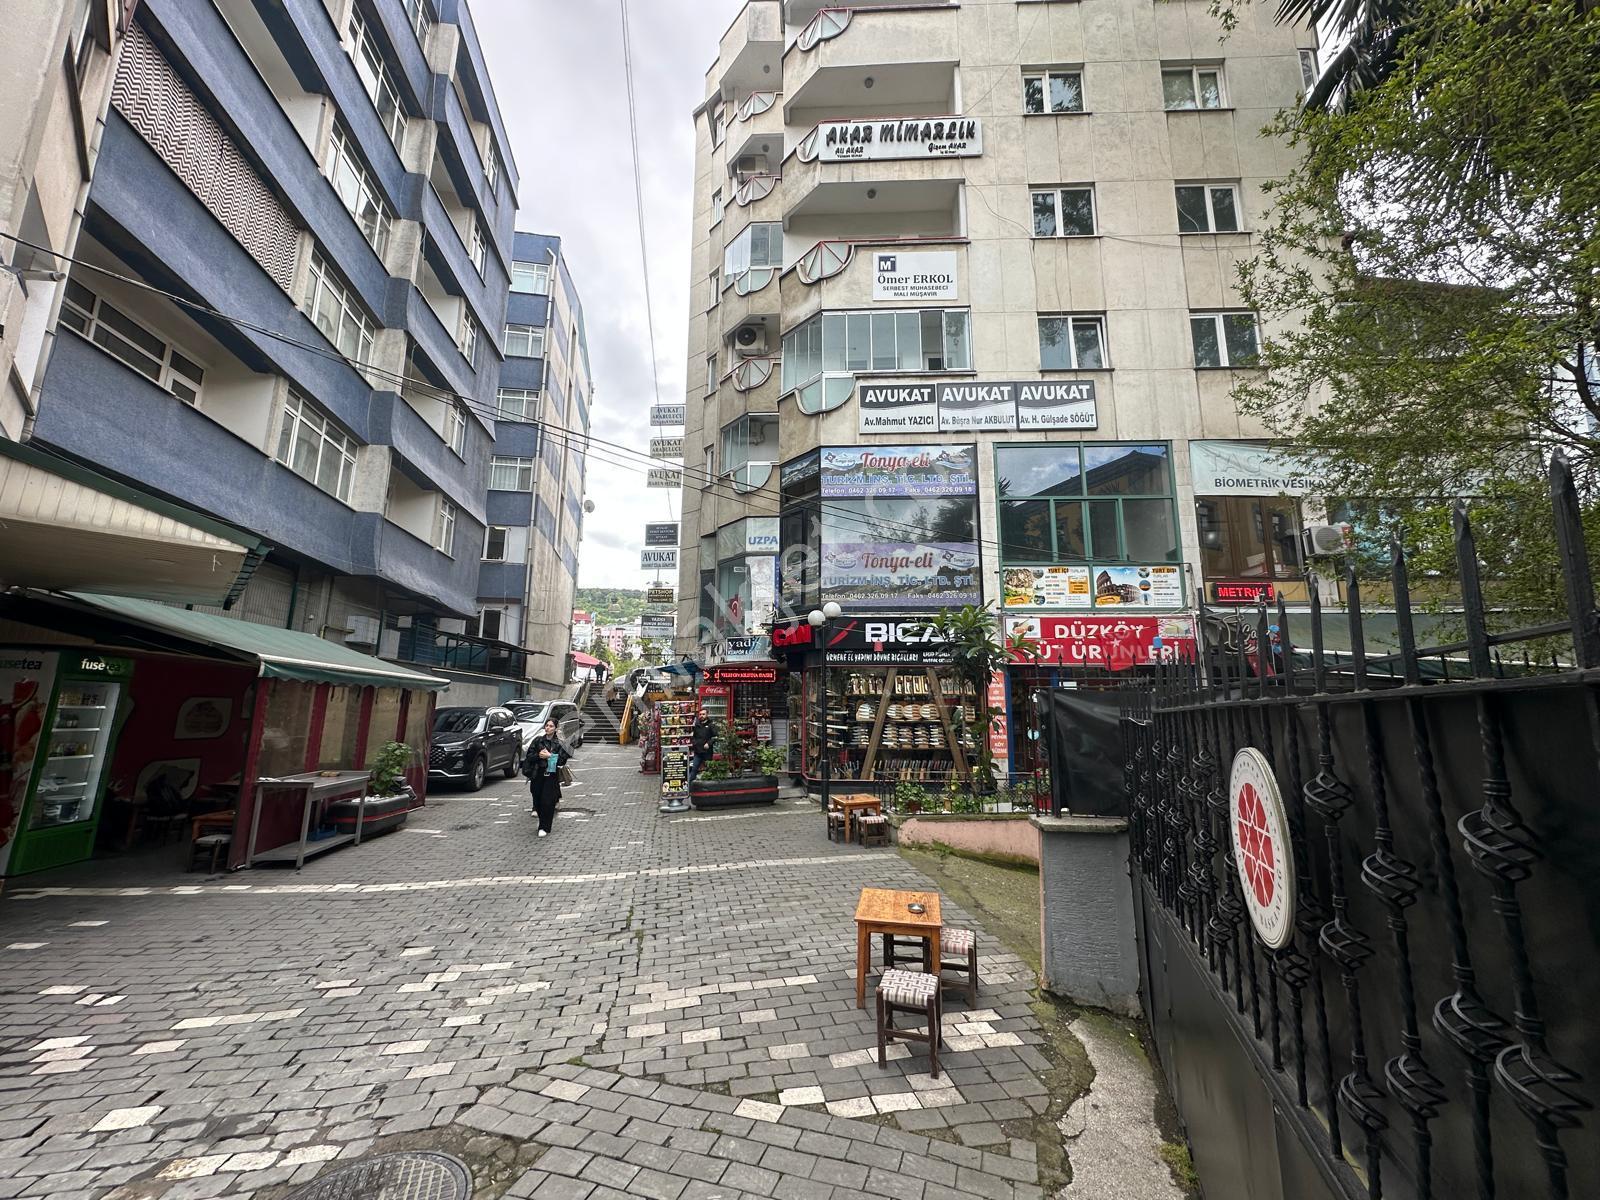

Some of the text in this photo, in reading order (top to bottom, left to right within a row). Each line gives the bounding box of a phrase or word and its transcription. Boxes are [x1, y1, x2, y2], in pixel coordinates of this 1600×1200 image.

[826, 120, 976, 146] AKAR MİMARLIK
[846, 146, 864, 154] AKAR
[878, 273, 954, 284] Ömer ERKOL
[865, 388, 932, 402] AVUKAT
[942, 386, 1012, 402] AVUKAT
[1020, 385, 1090, 400] AVUKAT
[908, 416, 934, 426] YAZICI
[941, 415, 1014, 427] Av. Büşra Nur AKBULUT
[1020, 412, 1094, 425] Av. H. Gülşade SÖĞÜT
[860, 452, 930, 472] Tonya-eli
[650, 470, 680, 479] AVUKAT
[1214, 476, 1279, 488] BİOMETRİK
[748, 536, 778, 544] UZPA
[643, 552, 675, 562] AVUKAT
[862, 552, 934, 573] Tonya-eli
[1054, 620, 1144, 639] DÜZKÖY
[1072, 641, 1180, 660] ÜRÜNLERİ
